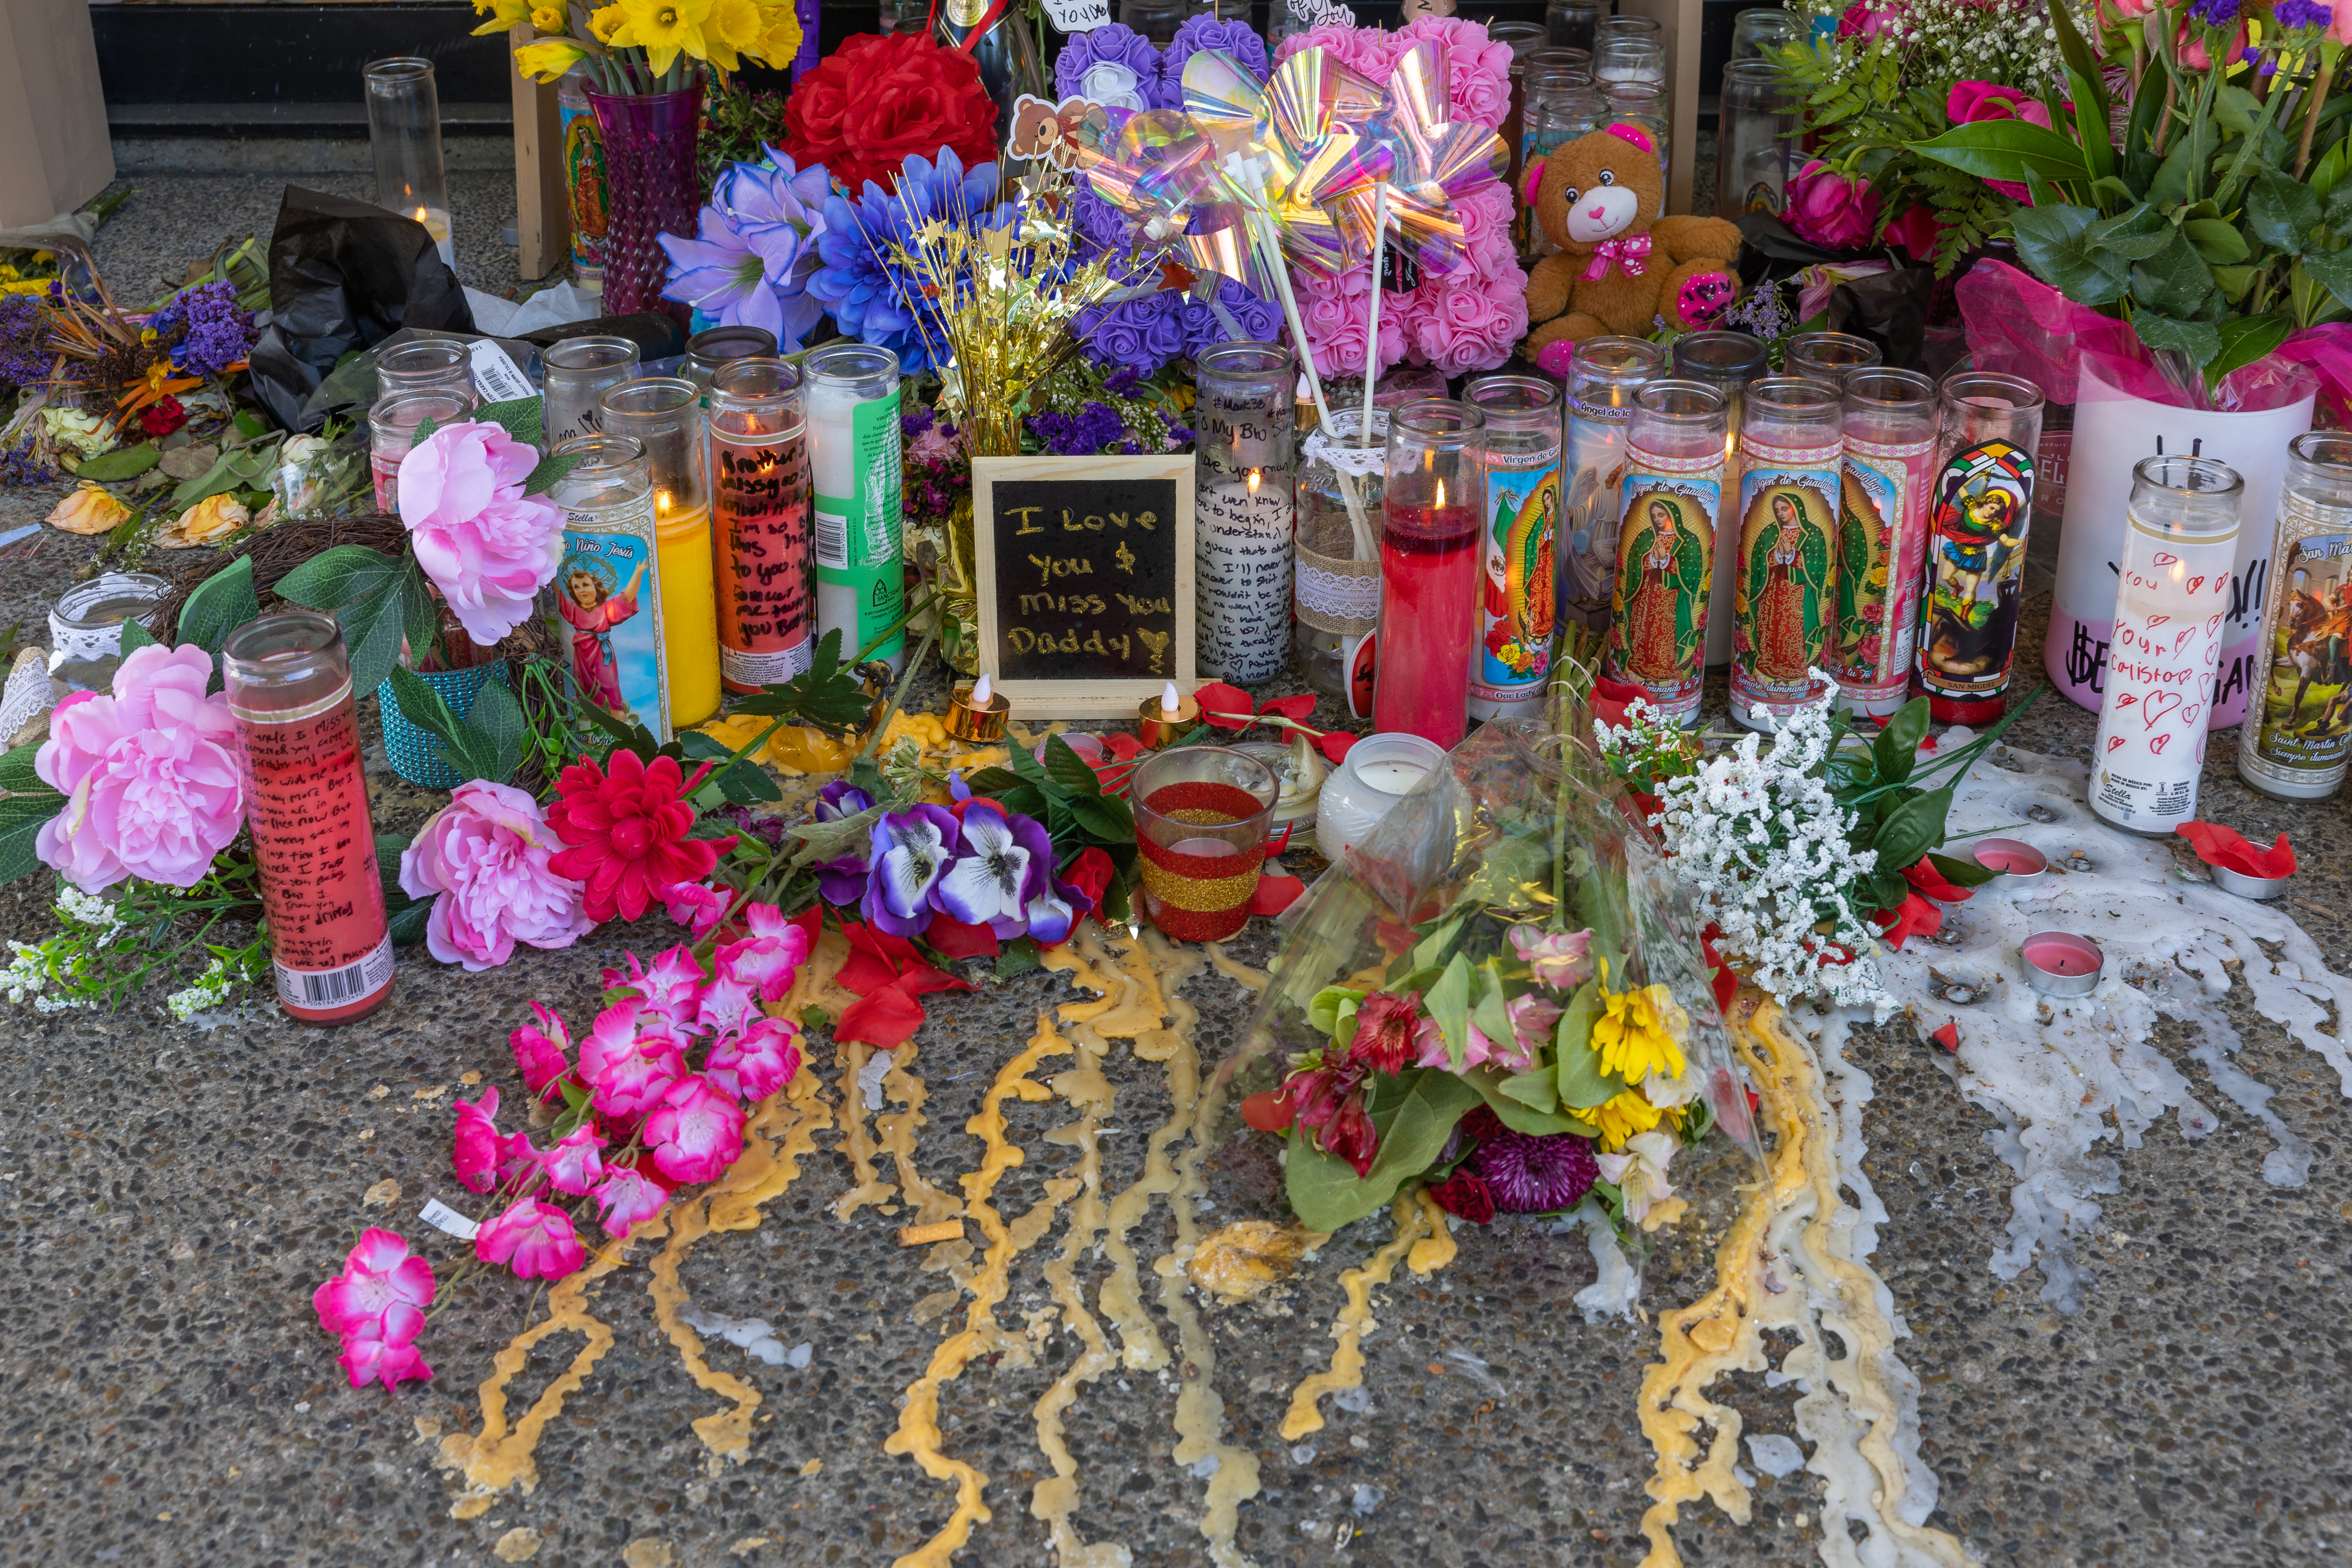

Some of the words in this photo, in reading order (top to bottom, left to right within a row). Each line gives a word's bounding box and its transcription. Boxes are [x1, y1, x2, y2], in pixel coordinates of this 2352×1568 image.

[498, 356, 511, 370] COLOMBIA
[511, 374, 521, 384] GROWN
[486, 393, 497, 401] STEM
[519, 384, 530, 396] PRODUCT
[877, 412, 891, 421] VIRGEN
[1581, 402, 1606, 416] Ángel
[1608, 409, 1621, 417] de
[1503, 455, 1535, 465] Virgen
[1537, 452, 1547, 461] de
[1750, 477, 1776, 492] Virgen
[1779, 472, 1792, 486] de
[1797, 475, 1837, 496] Guadalupe
[1842, 459, 1887, 496] Guadalupe
[1630, 481, 1653, 497] Virgen
[1657, 479, 1670, 493] de
[1674, 482, 1716, 505] Guadalupe
[878, 500, 892, 508] VIRGIN
[568, 512, 594, 522] Stella
[1004, 506, 1044, 535] I
[1062, 510, 1158, 531] Love
[1272, 507, 1282, 521] I
[575, 537, 601, 553] Niño
[604, 541, 634, 559] Jesús
[2298, 546, 2324, 564] San
[1258, 591, 1272, 599] be
[1009, 627, 1130, 661] Daddy
[1847, 668, 1857, 677] tu
[1859, 669, 1871, 680] Fe
[1684, 680, 1692, 690] tu
[1735, 674, 1764, 691] Siempre
[1766, 680, 1811, 693] iluminando
[1813, 679, 1820, 689] tu
[1967, 681, 1996, 690] MIGUEL
[1516, 689, 1535, 699] Lady
[1536, 684, 1544, 693] of
[2269, 732, 2300, 748] Saint
[2302, 739, 2336, 750] Martin
[2270, 746, 2307, 763] Siempre
[2309, 745, 2347, 762] iluminando
[2104, 784, 2131, 800] Stella
[297, 862, 312, 875] I
[338, 991, 363, 1003] 203490
